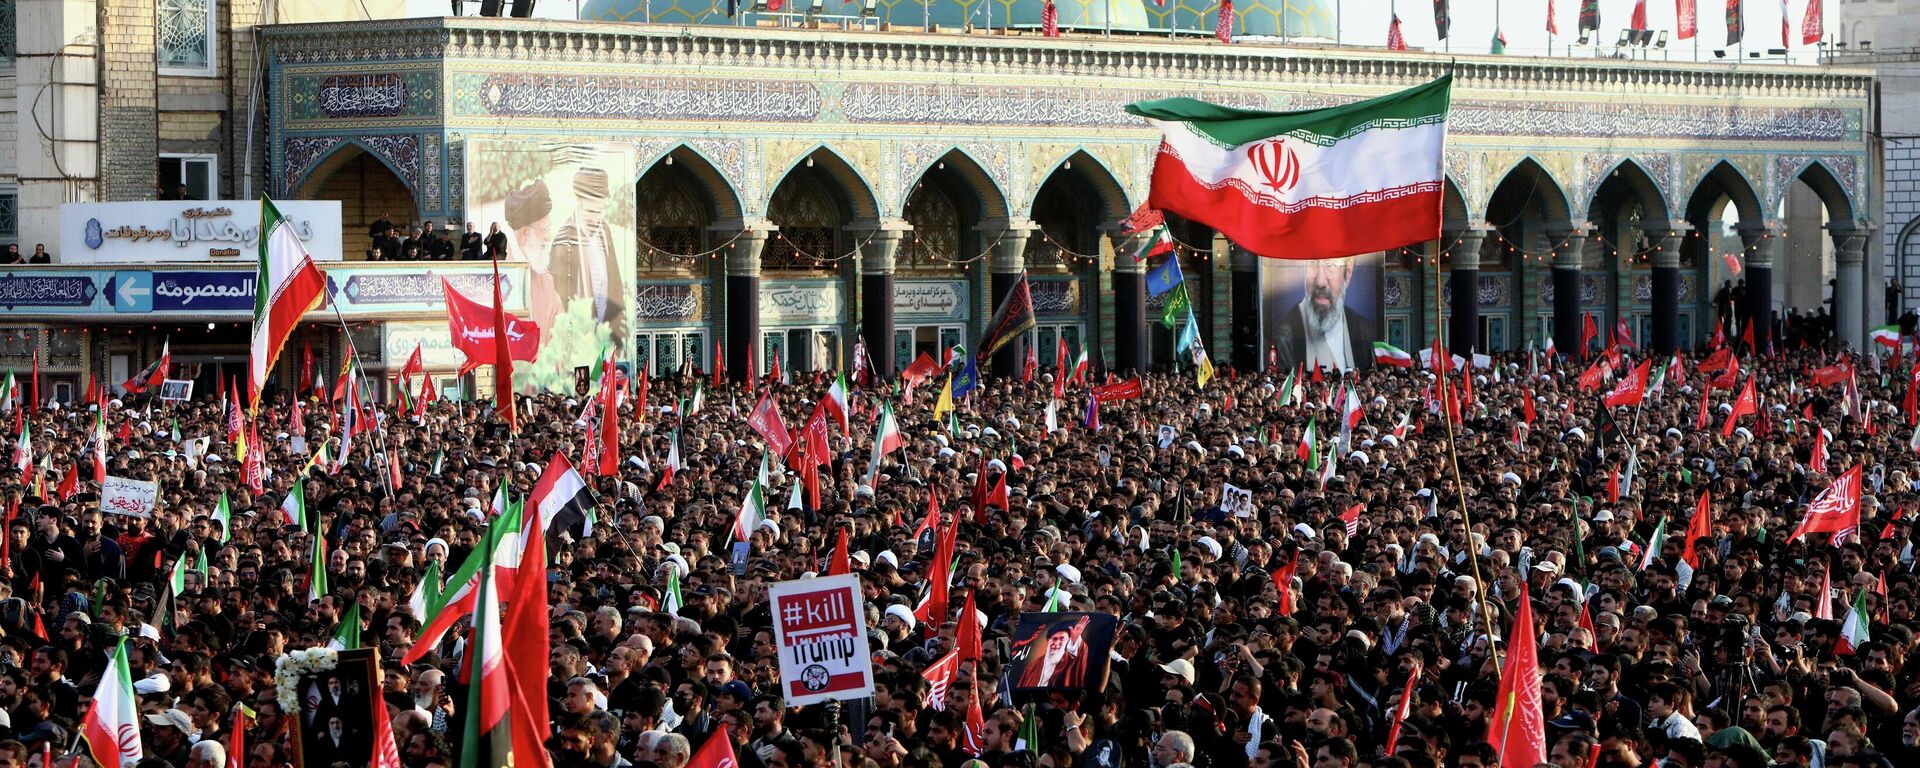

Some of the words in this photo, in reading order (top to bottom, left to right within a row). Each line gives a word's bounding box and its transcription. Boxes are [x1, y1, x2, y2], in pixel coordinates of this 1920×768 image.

[171, 217, 243, 248] هدایا
[916, 286, 933, 296] امداد
[932, 286, 948, 298] مرکز
[783, 592, 846, 626] #kill
[786, 623, 855, 666] Trump
